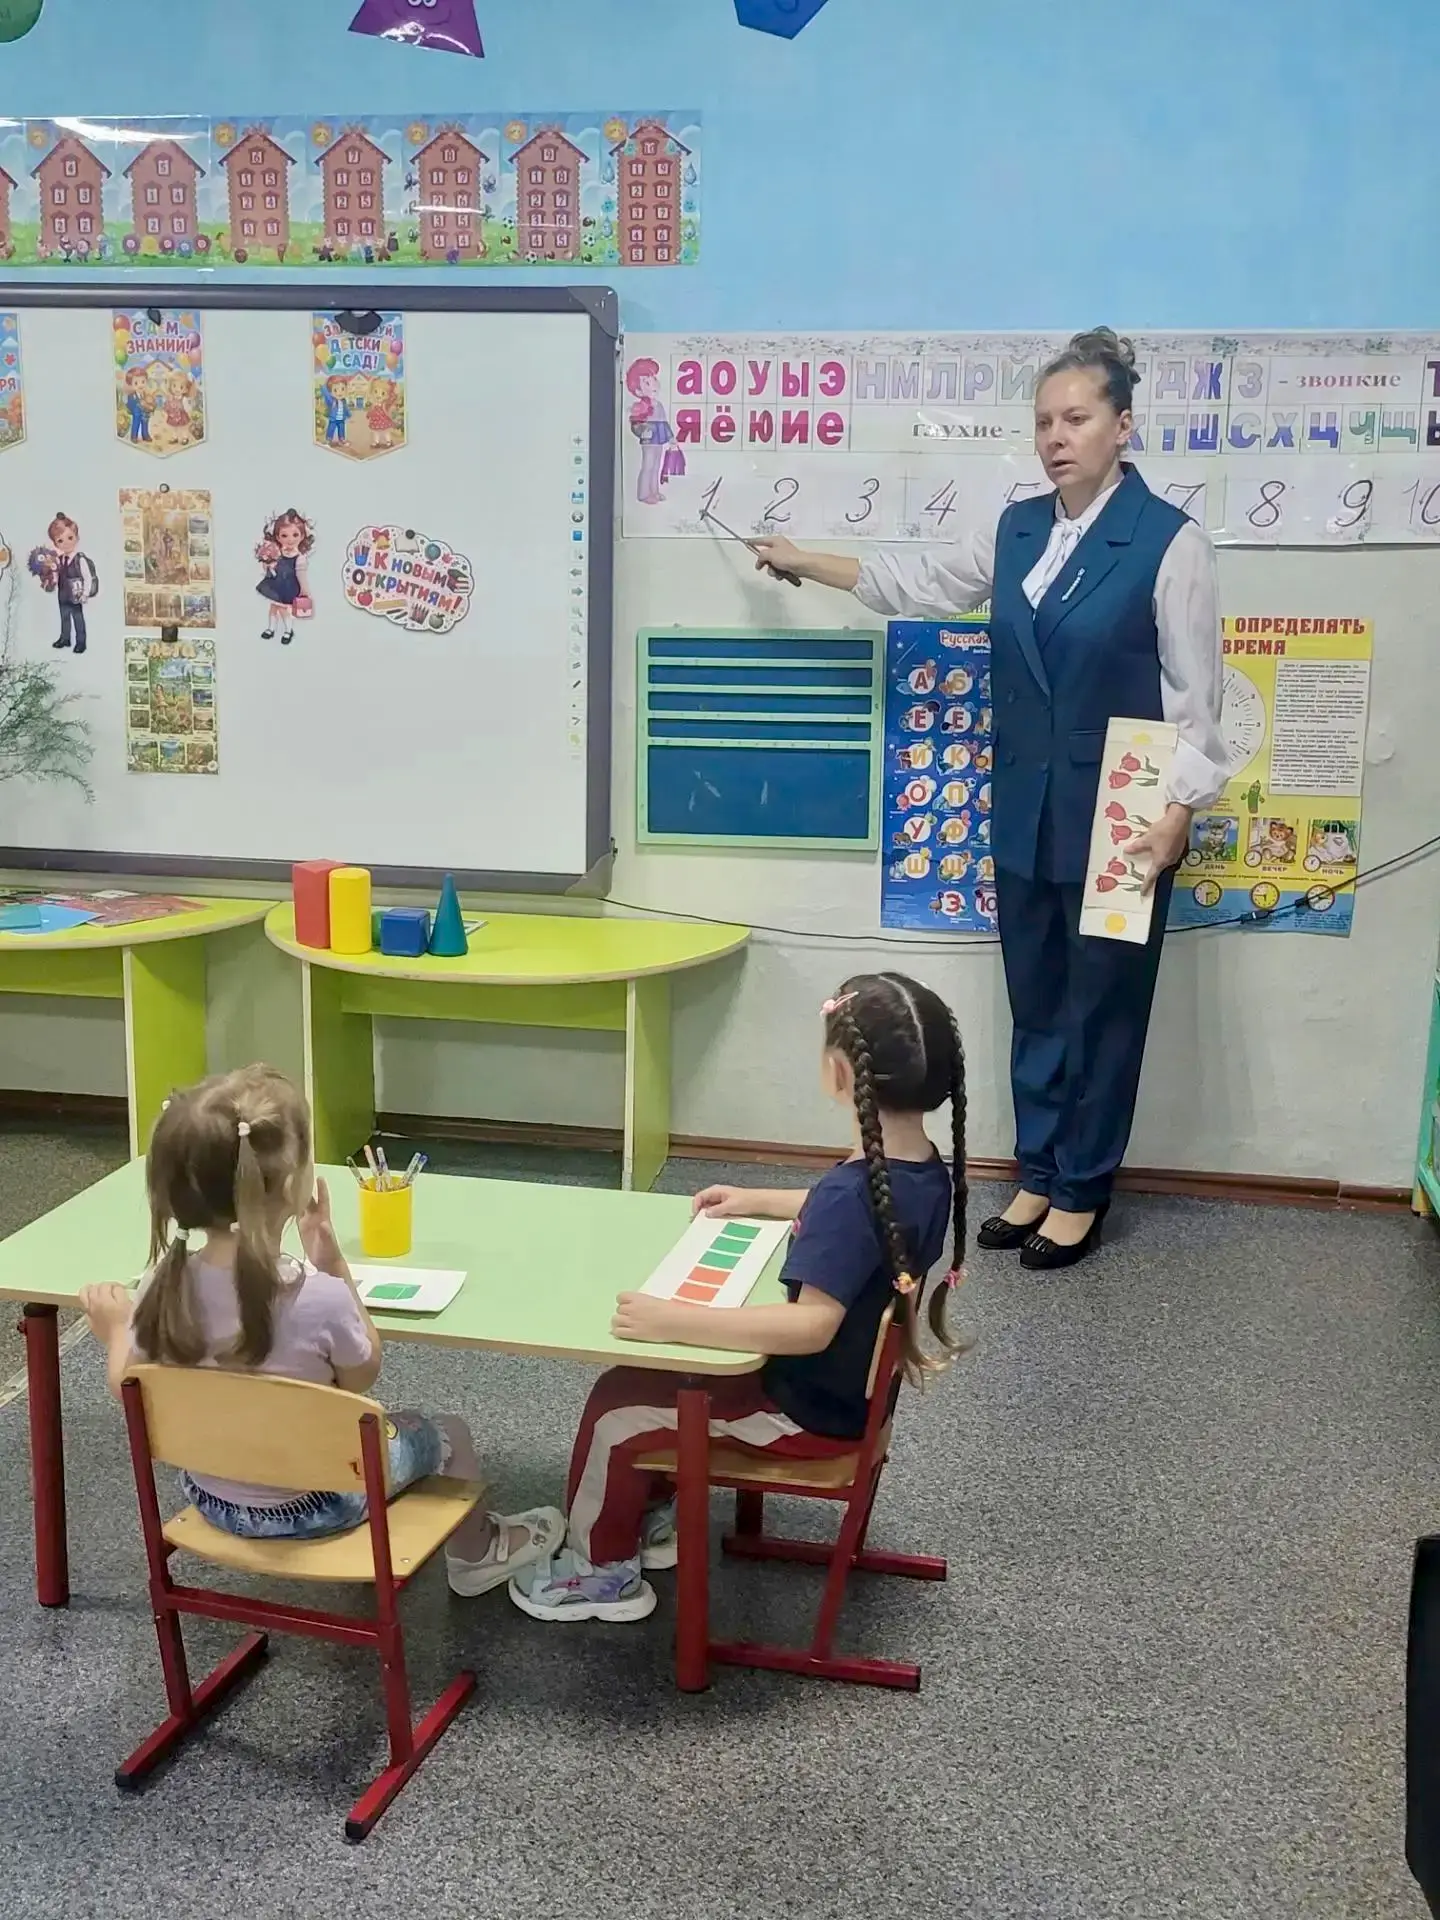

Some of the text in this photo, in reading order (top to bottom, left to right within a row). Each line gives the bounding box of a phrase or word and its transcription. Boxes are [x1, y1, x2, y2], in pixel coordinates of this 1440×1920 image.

[132, 321, 143, 335] С
[342, 353, 378, 369] САД!
[1296, 374, 1402, 389] звонкие
[763, 477, 800, 523] 2
[845, 477, 880, 523] 3
[924, 479, 958, 526] 4
[1248, 480, 1286, 528] 8
[1334, 479, 1373, 528] 9
[373, 551, 389, 571] К
[1234, 617, 1366, 637] ОПРЕДЕЛЯТЬ
[941, 631, 989, 646] Русская
[1222, 639, 1286, 656] ВРЕМЯ
[913, 671, 929, 690] А
[914, 709, 927, 729] Е
[912, 746, 965, 766] И К
[910, 783, 964, 804] О П
[910, 820, 925, 840] У
